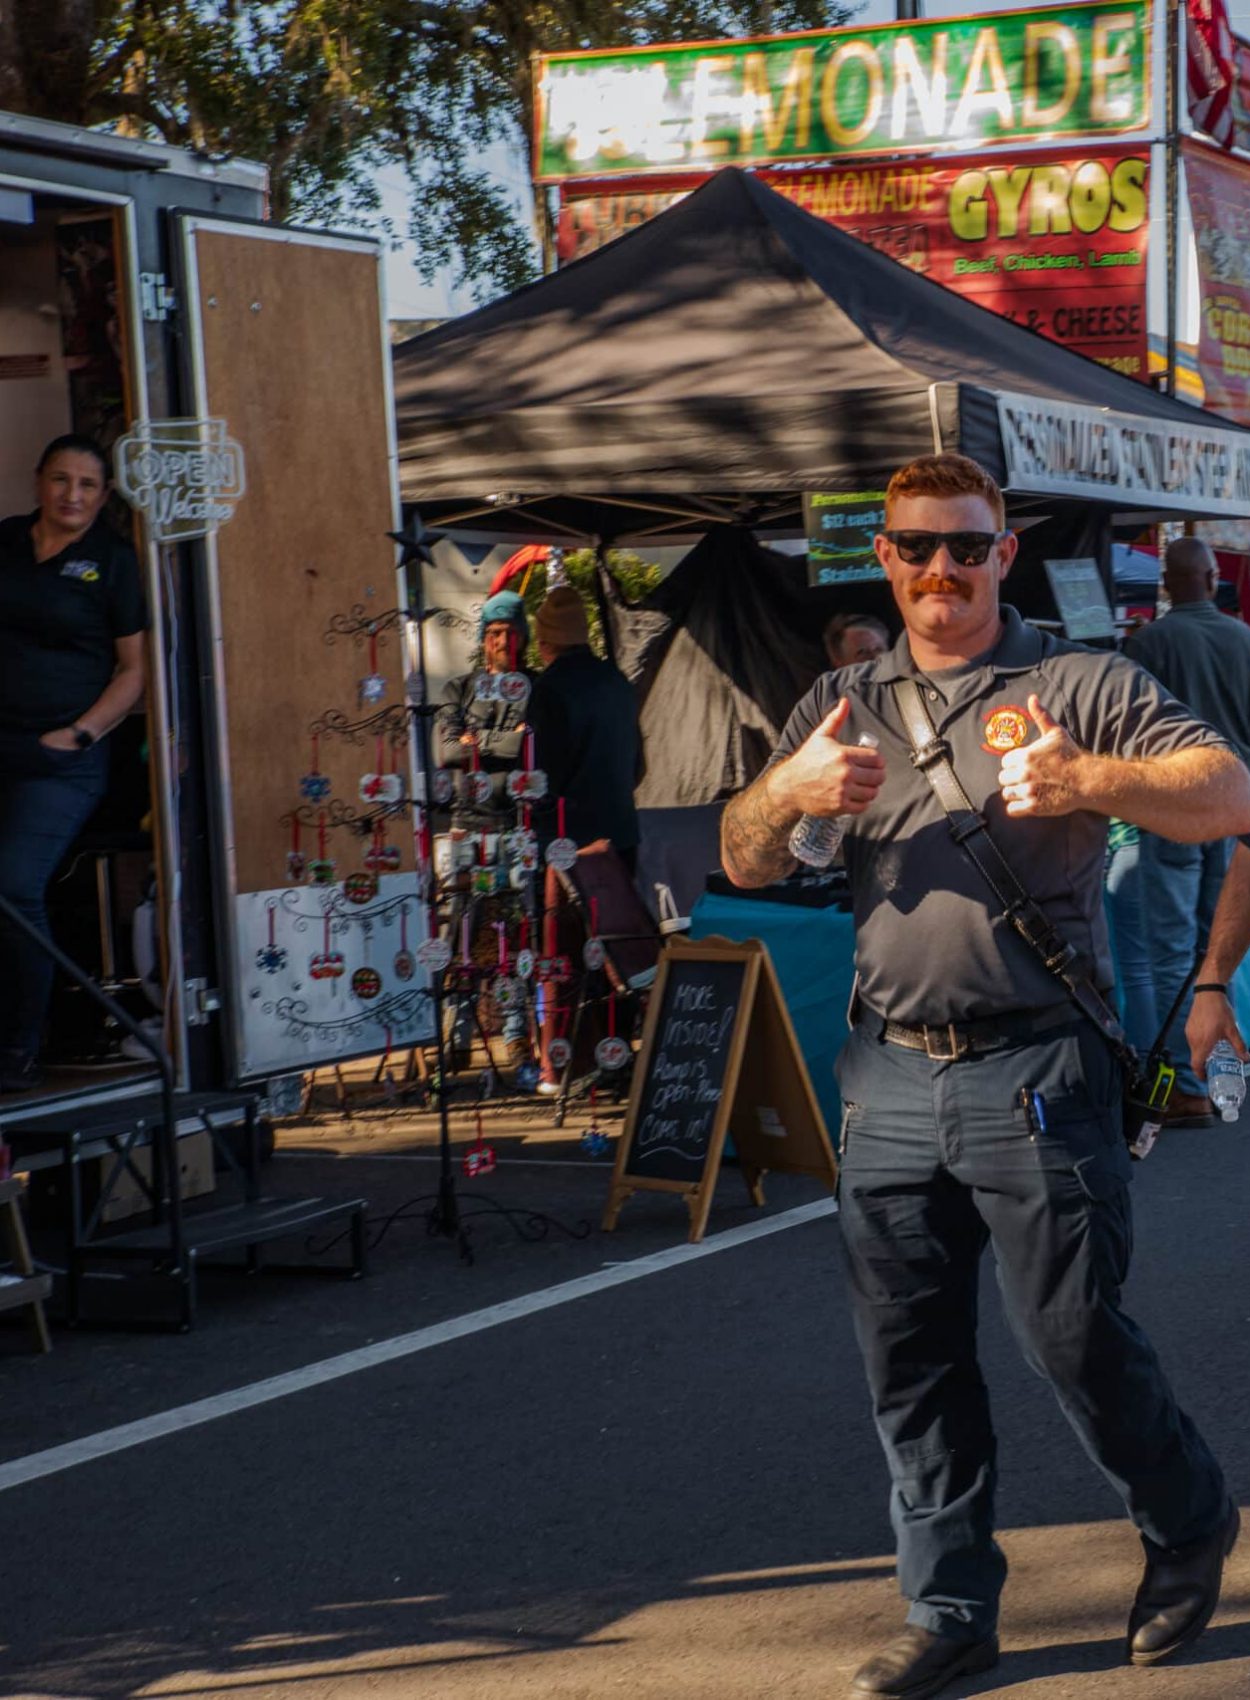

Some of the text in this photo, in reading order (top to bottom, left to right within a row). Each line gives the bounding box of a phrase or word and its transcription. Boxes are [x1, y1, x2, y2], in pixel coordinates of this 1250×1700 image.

[646, 12, 1138, 164] LEMONADE
[949, 157, 1148, 242] GYROS
[954, 249, 1142, 275] Beef, Chicken, Lamb
[1053, 304, 1142, 338] CHEESE
[133, 449, 236, 487] OPEN
